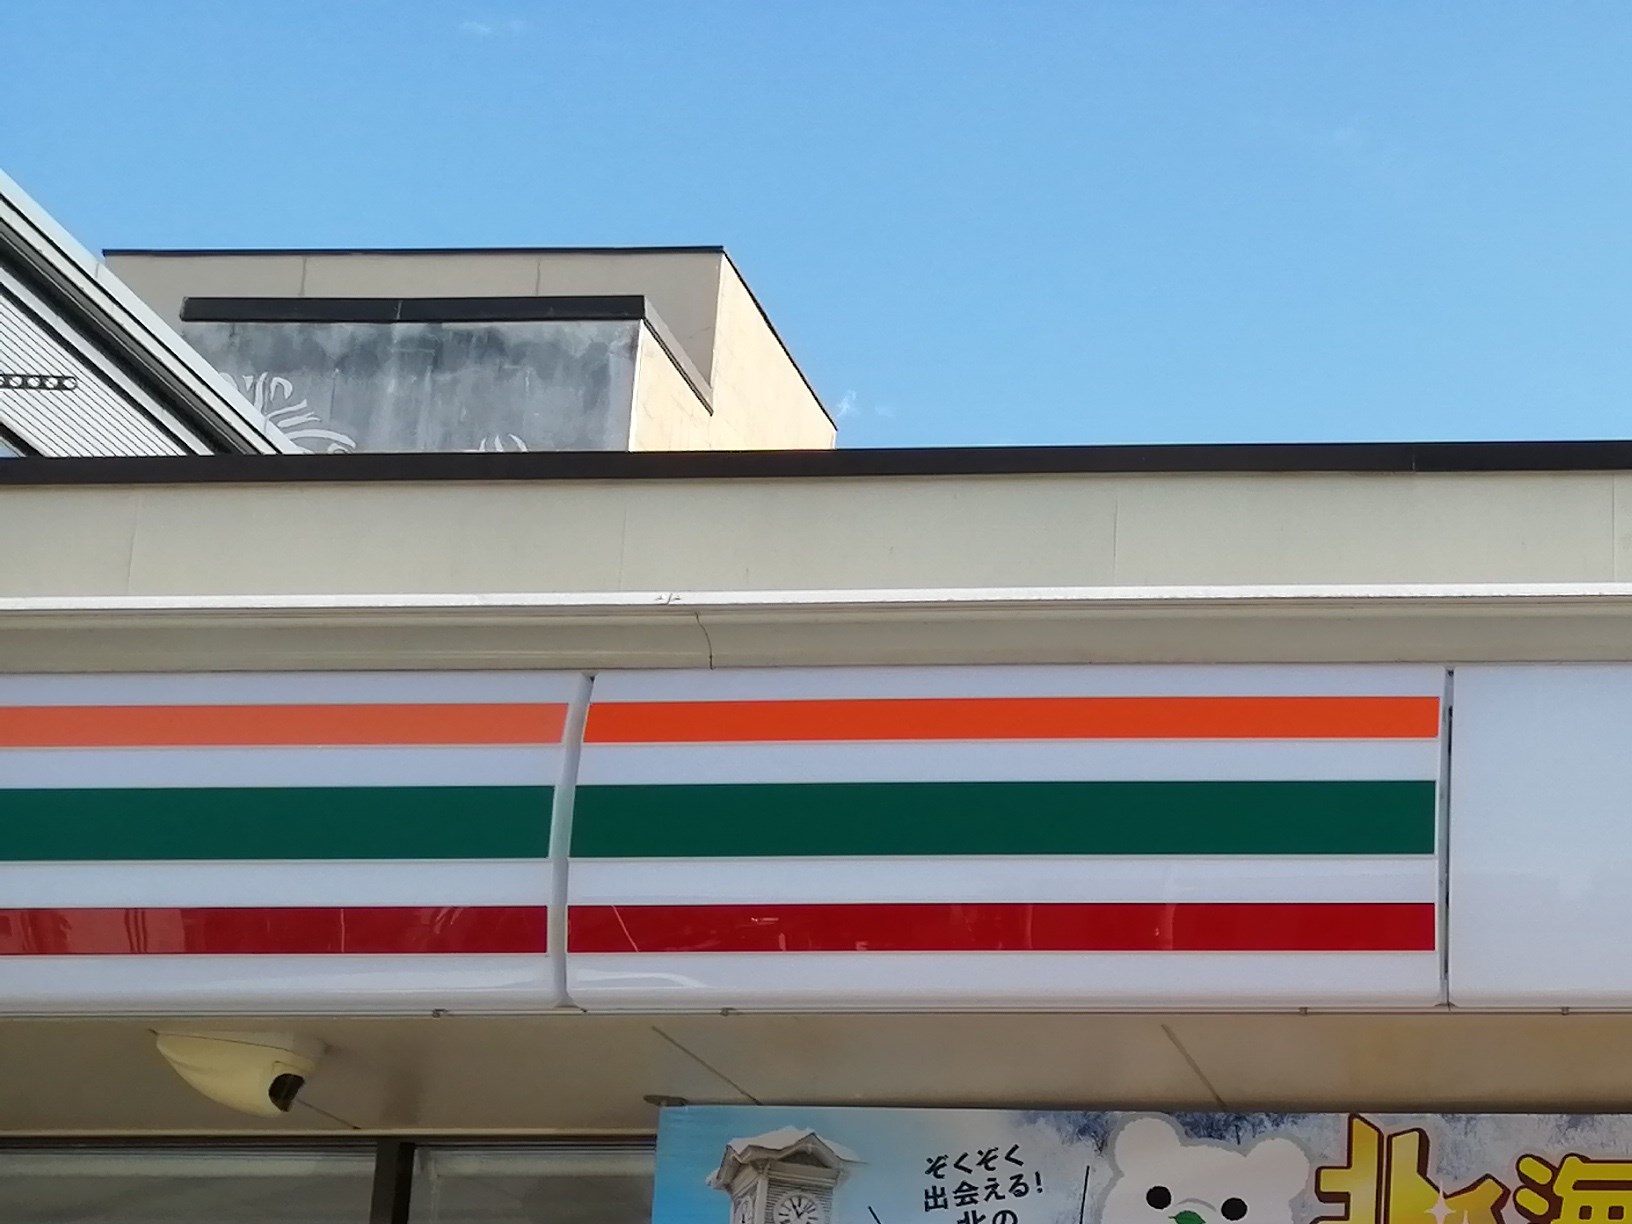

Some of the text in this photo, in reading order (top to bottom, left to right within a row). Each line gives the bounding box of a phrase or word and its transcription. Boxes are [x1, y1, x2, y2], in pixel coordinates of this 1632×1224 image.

[926, 1145, 1024, 1179] ぞくぞく
[925, 1172, 1045, 1212] 出会える!
